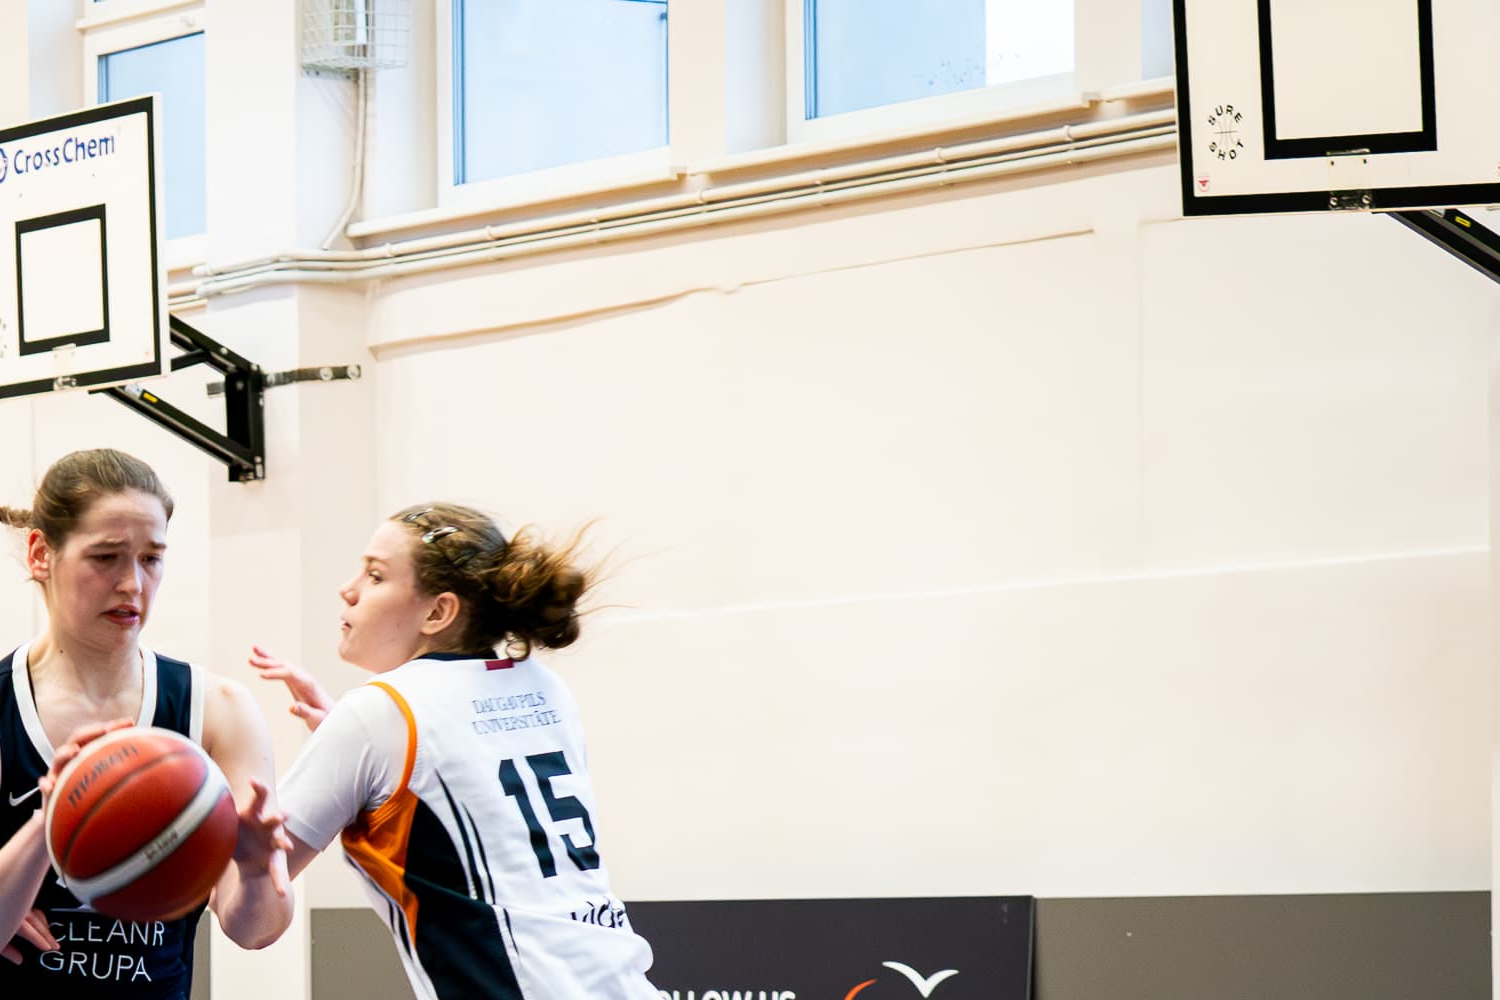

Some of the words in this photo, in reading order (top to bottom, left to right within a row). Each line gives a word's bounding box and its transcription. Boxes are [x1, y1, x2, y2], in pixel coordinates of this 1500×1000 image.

[13, 136, 115, 174] CrossChem
[498, 751, 600, 878] 15
[49, 919, 165, 946] CLEANR
[40, 951, 152, 982] GRUPA
